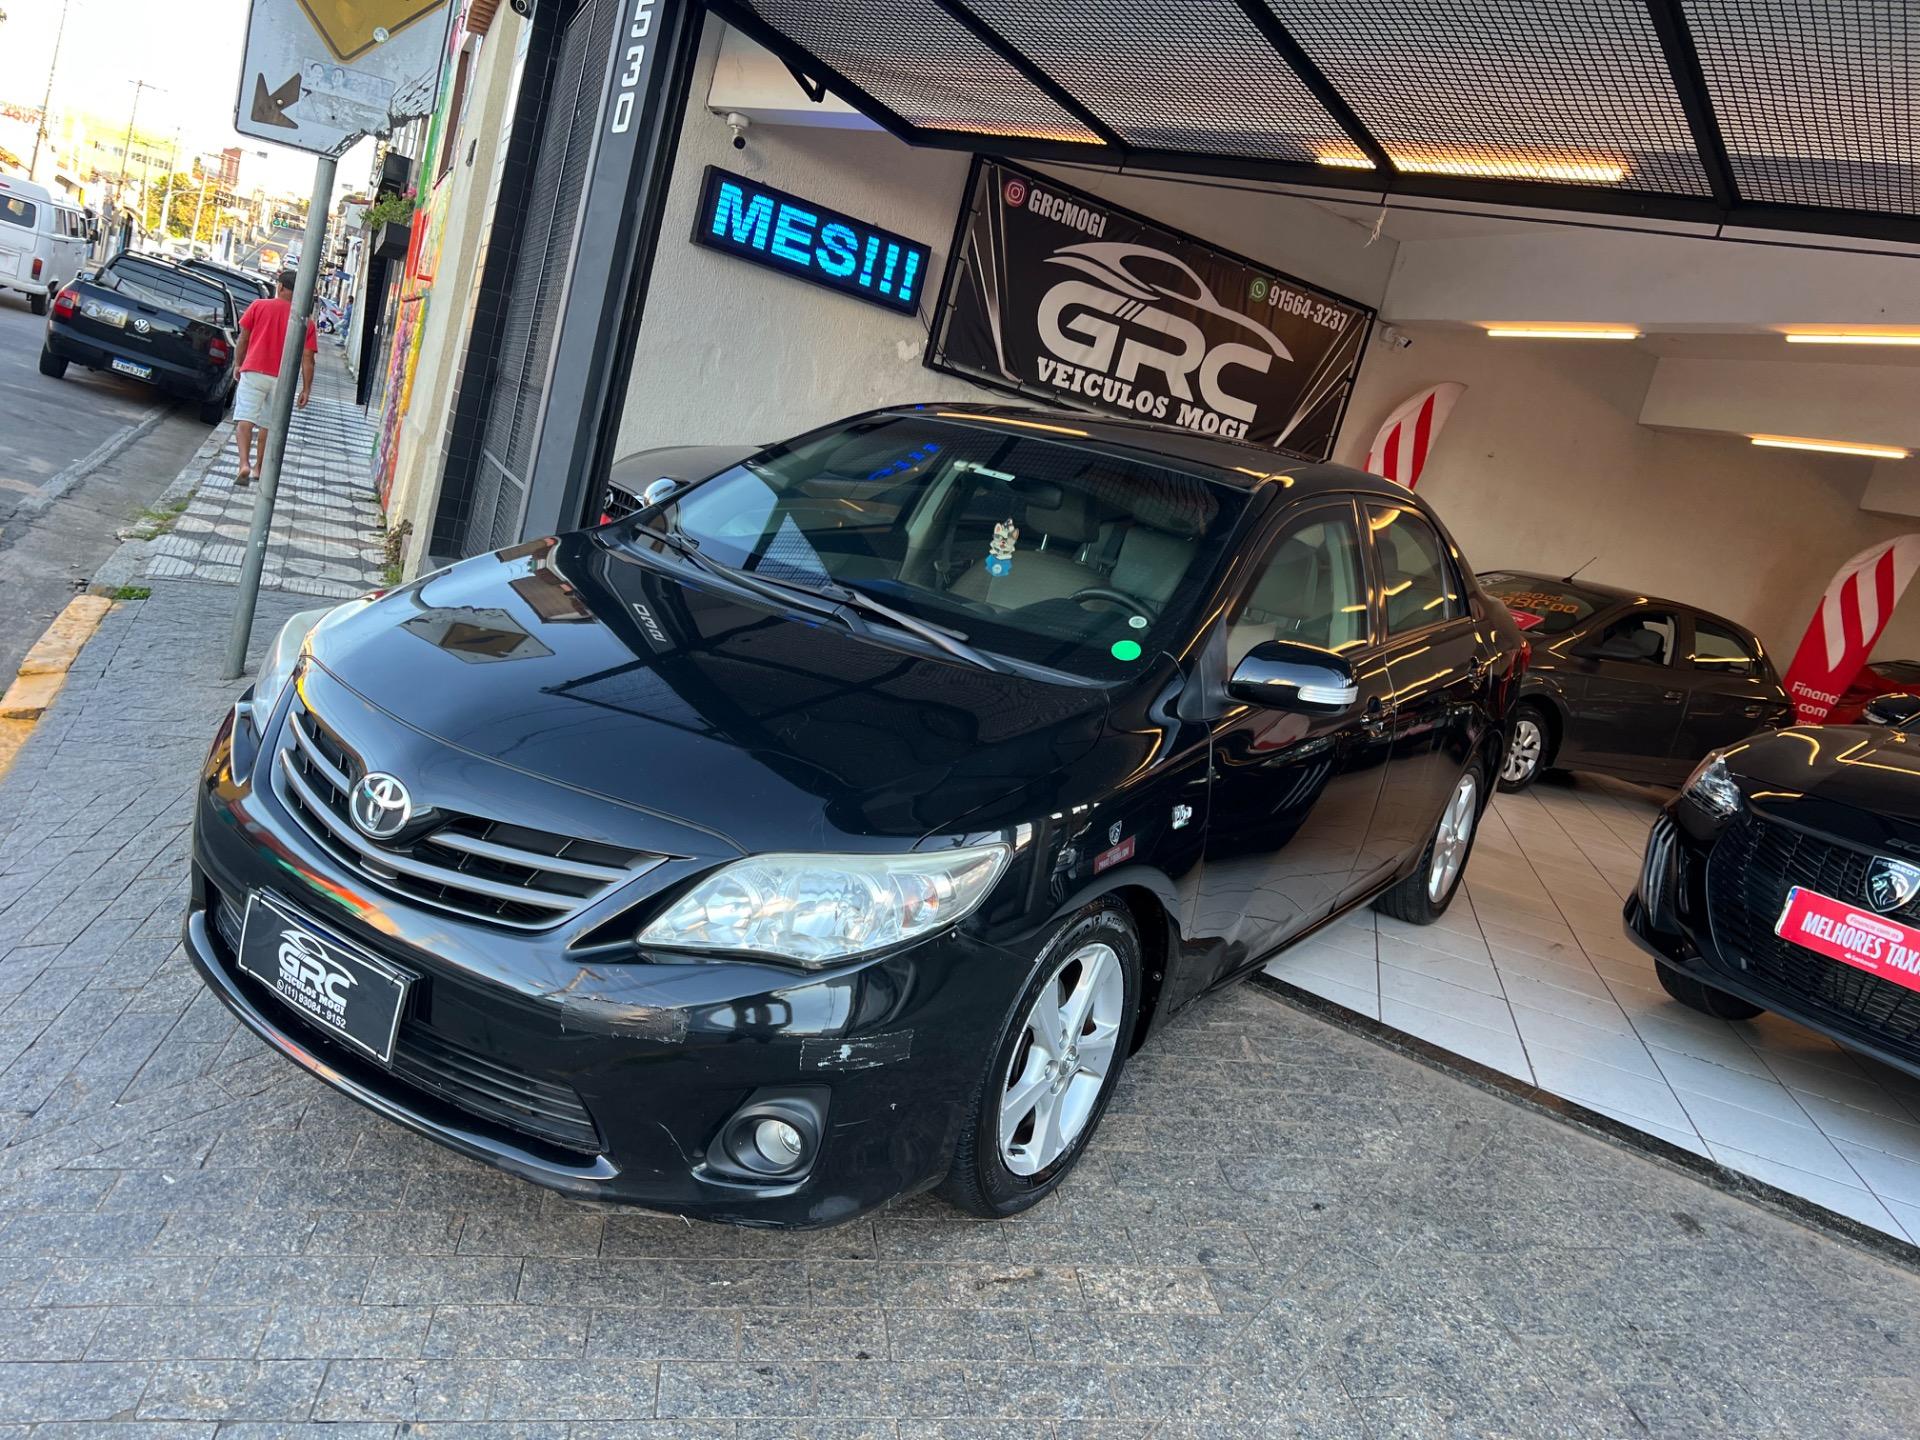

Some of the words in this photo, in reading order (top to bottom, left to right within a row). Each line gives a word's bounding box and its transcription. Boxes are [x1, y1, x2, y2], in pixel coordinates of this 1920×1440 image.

[612, 0, 655, 133] 530
[1028, 189, 1107, 238] GRCMOGI
[712, 182, 920, 301] MES!!!
[1269, 286, 1349, 332] 91564-3237
[1037, 280, 1273, 423] GRC
[1037, 356, 1169, 418] VEICULOS
[1176, 403, 1249, 439] MOGI
[1798, 703, 1828, 718] com
[1800, 911, 1886, 959] MELHORES
[279, 942, 350, 1007] GRC
[279, 967, 317, 999] VEICULOS
[319, 993, 346, 1015] MOGI
[284, 983, 298, 1001] (11)
[326, 1010, 347, 1029] 9152
